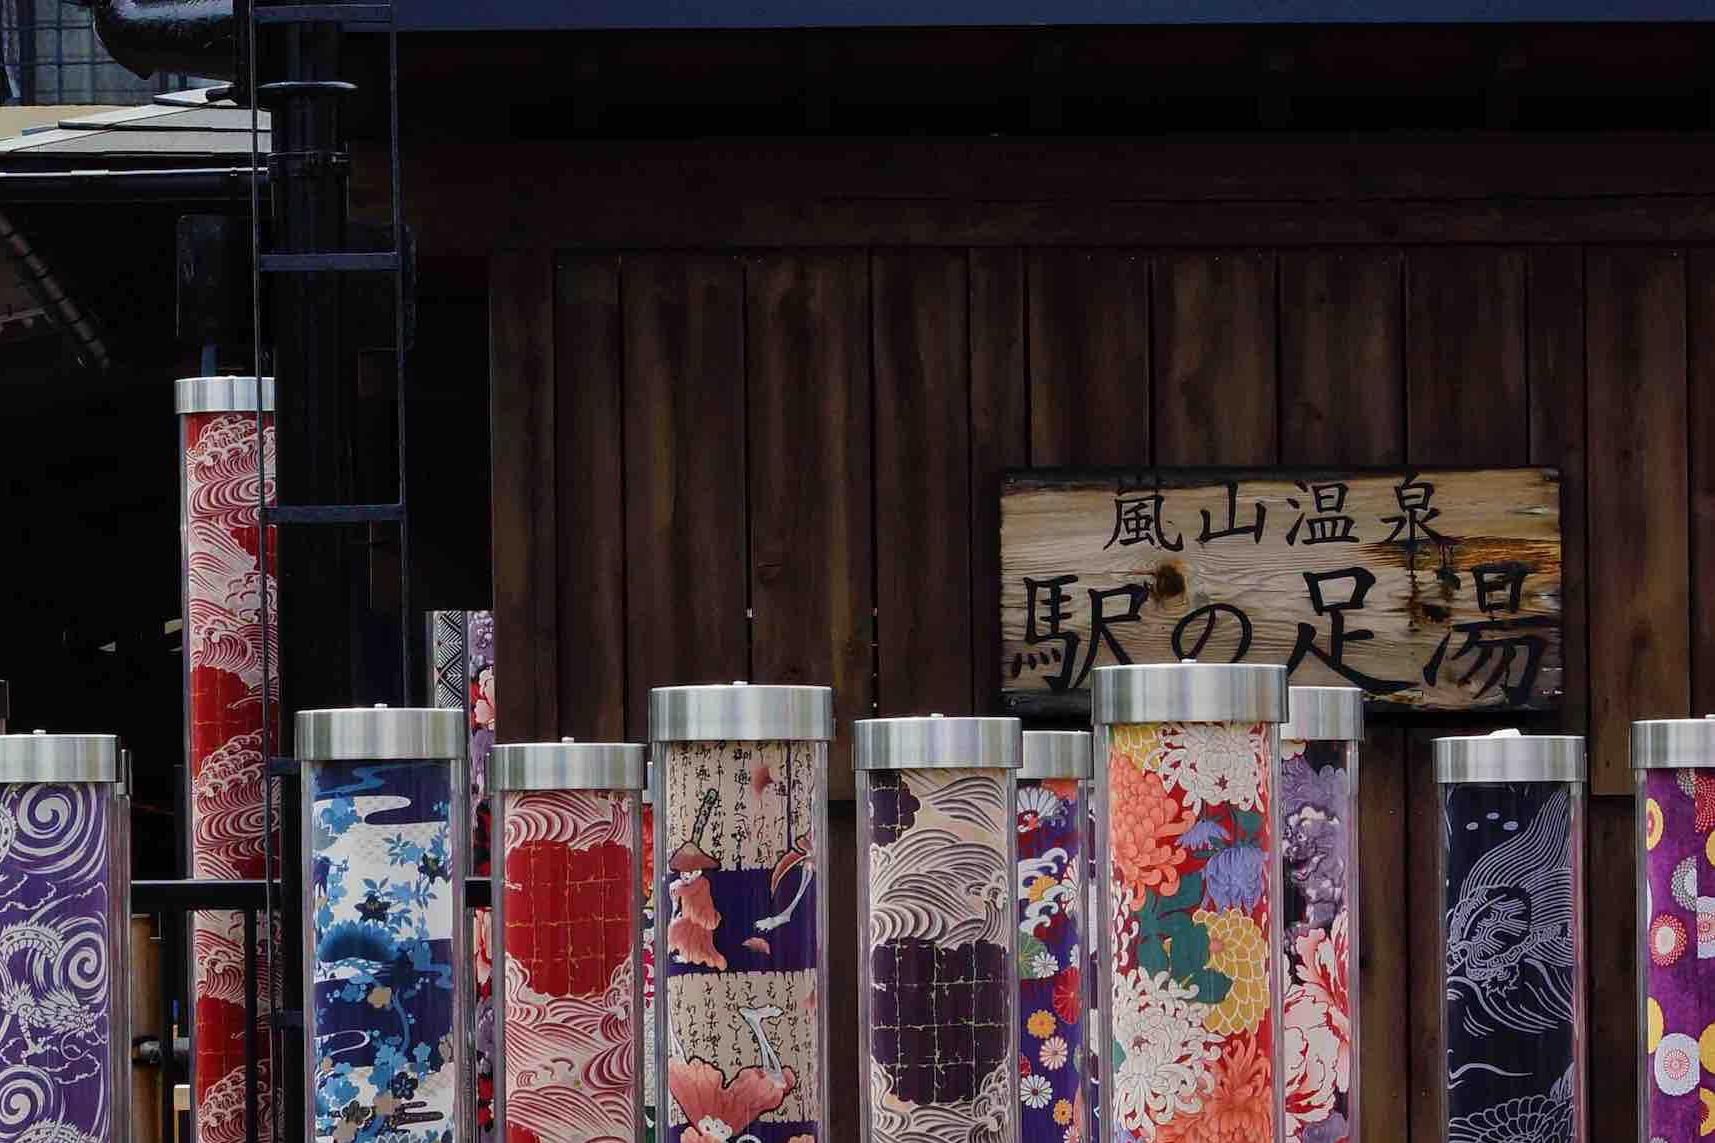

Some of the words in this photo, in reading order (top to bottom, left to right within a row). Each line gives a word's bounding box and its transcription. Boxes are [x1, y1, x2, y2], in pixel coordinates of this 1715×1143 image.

[1103, 472, 1446, 552] 嵐山温泉
[1011, 564, 1553, 699] 駅の足湯
